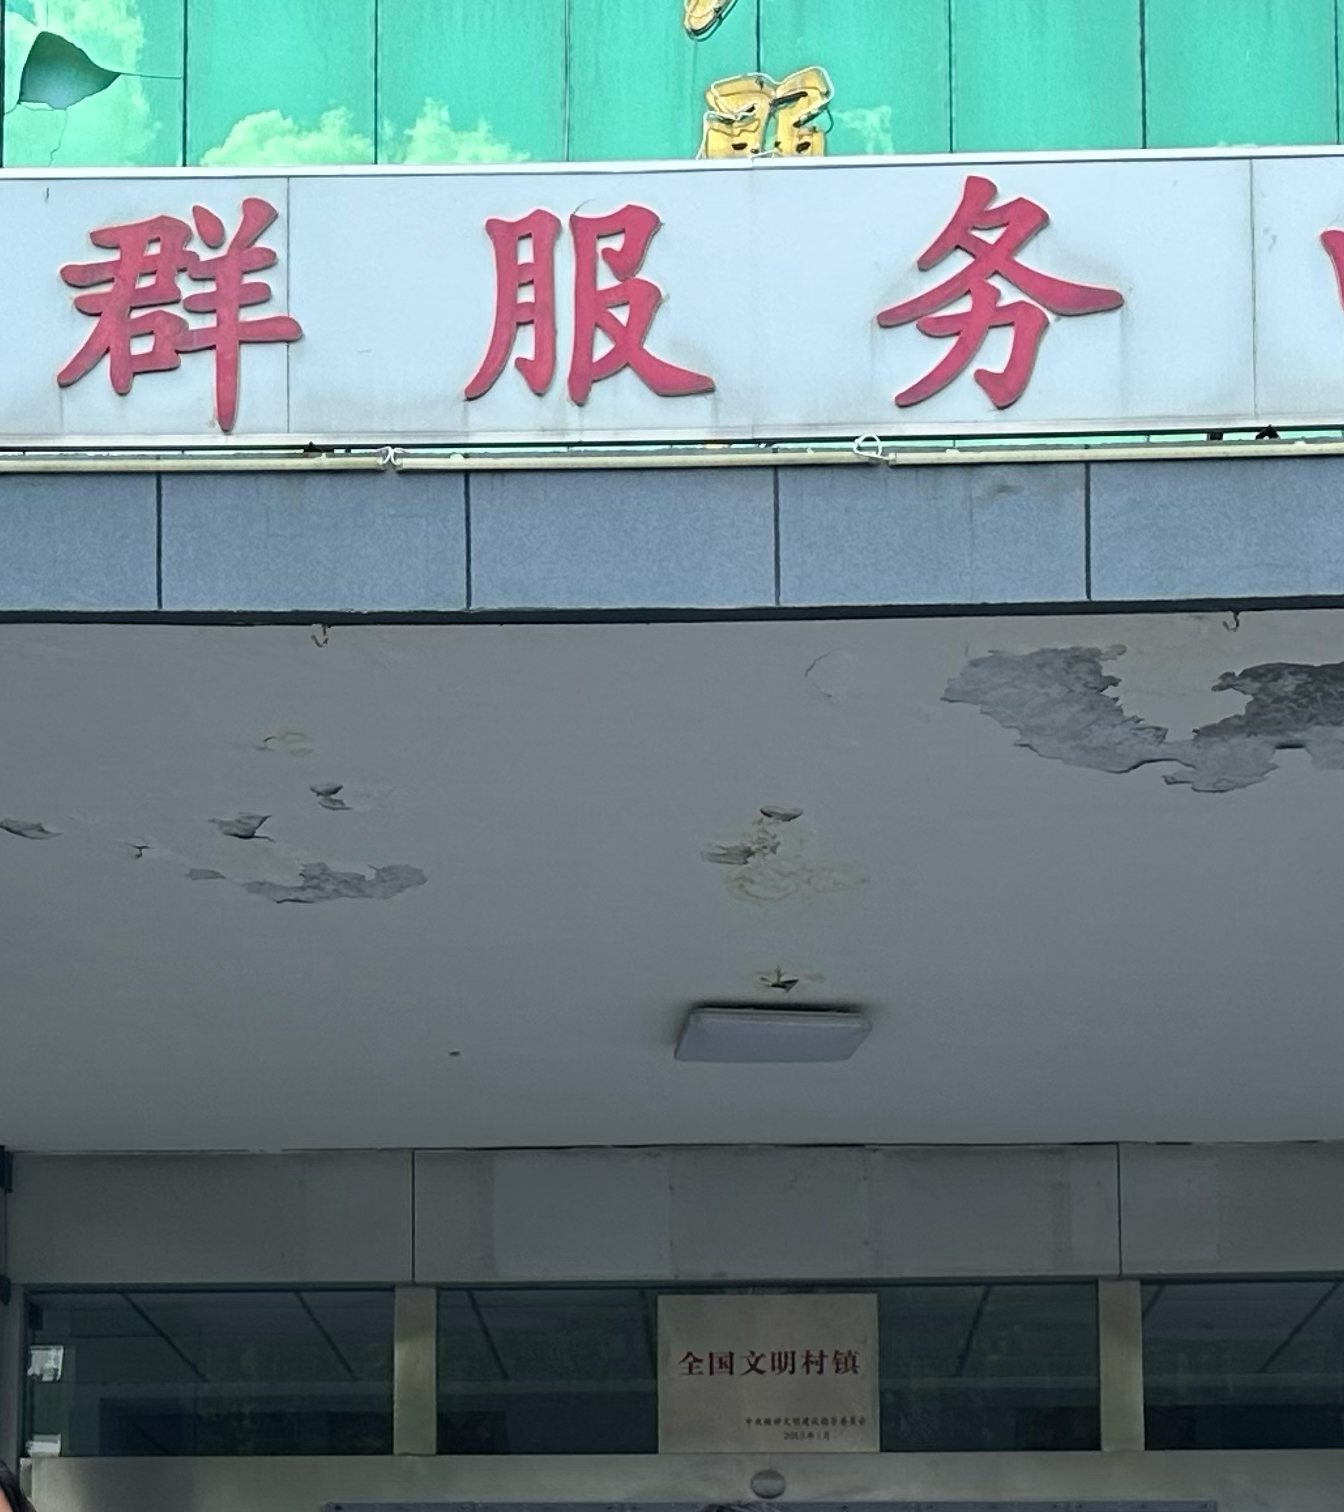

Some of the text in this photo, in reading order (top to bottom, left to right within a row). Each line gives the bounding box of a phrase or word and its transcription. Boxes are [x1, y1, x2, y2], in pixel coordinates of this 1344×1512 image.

[677, 1348, 861, 1377] 全国文明村镇
